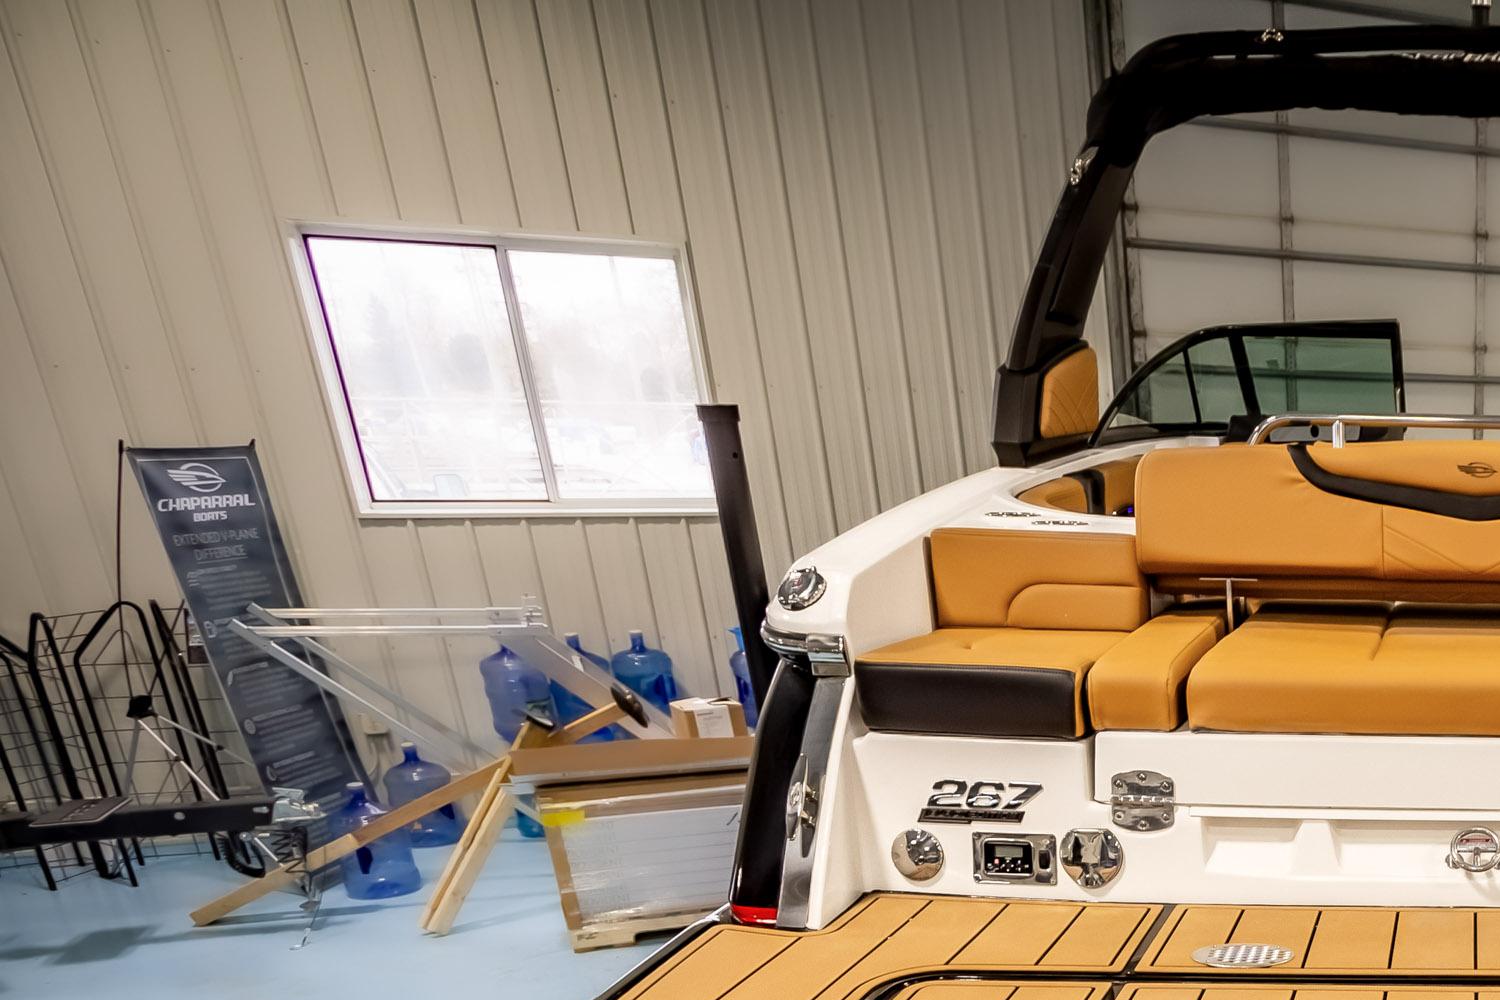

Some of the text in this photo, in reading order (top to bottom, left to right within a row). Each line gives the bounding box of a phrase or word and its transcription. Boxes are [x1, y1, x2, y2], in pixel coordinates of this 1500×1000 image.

[158, 494, 256, 511] CHAPARRAL
[193, 511, 228, 522] BOATS
[172, 531, 221, 547] EXTENDED
[194, 544, 248, 561] DIFFERENCE
[926, 779, 1044, 810] 267
